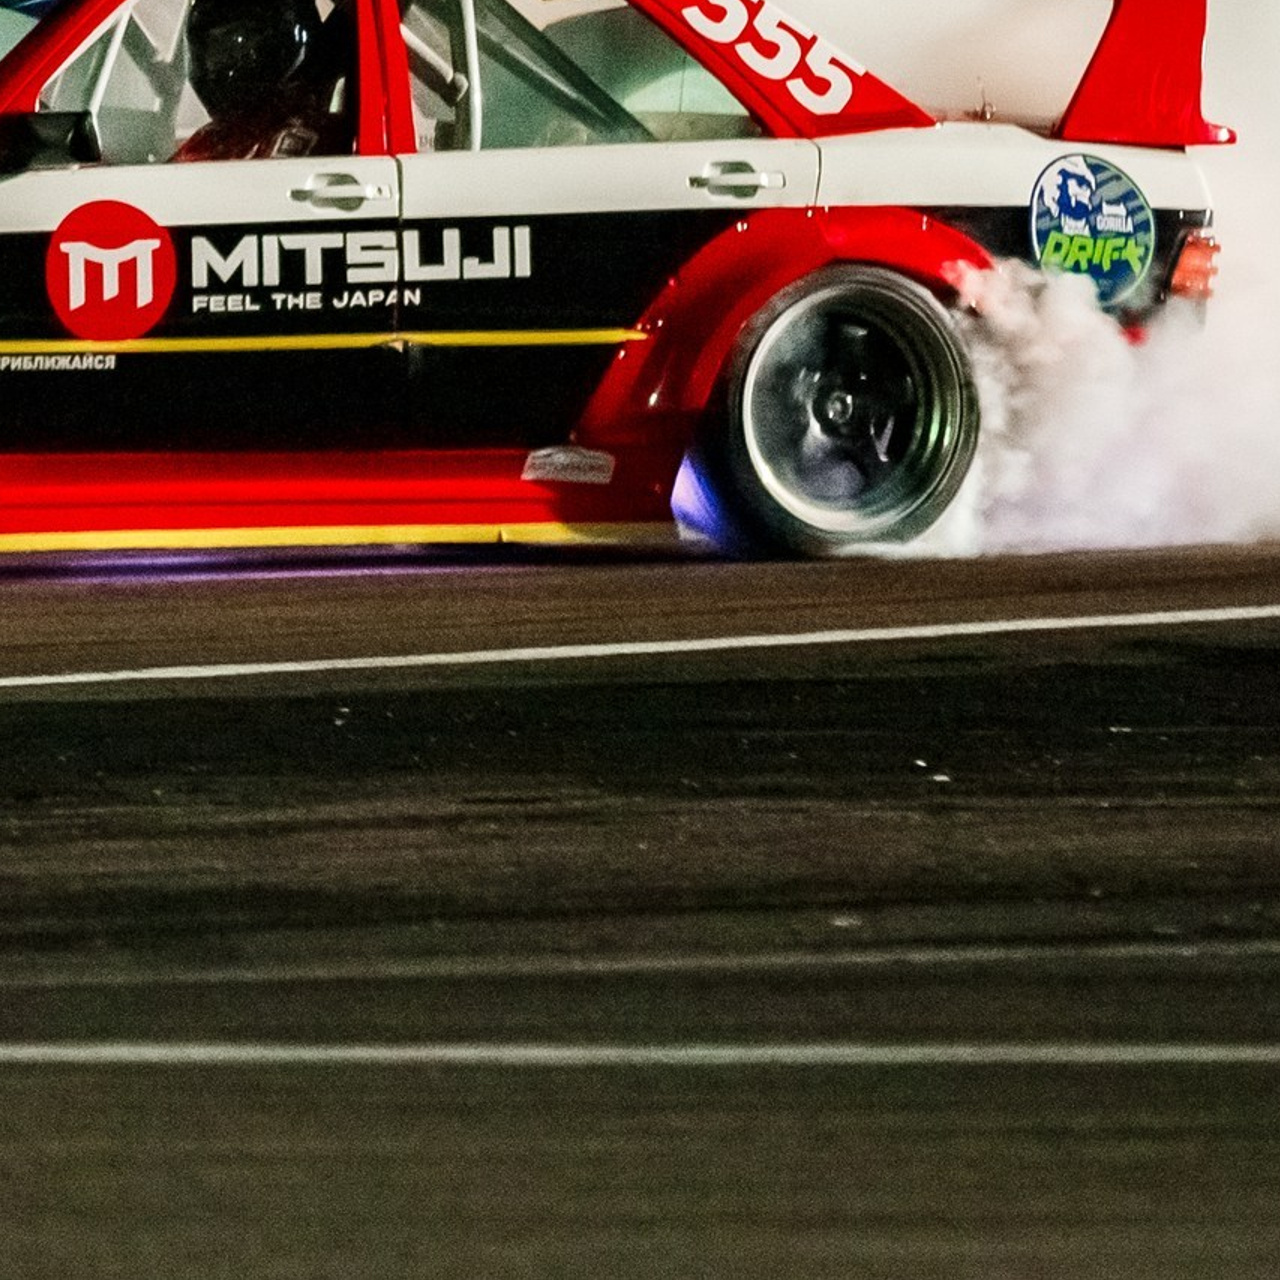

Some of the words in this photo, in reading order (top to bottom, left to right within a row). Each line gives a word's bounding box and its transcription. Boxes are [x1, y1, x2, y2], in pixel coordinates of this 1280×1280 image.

[192, 226, 531, 288] MITSUJI
[1041, 231, 1146, 276] DRIFT
[192, 294, 260, 312] FEEL
[271, 293, 323, 309] THE
[332, 289, 421, 308] JAPAN
